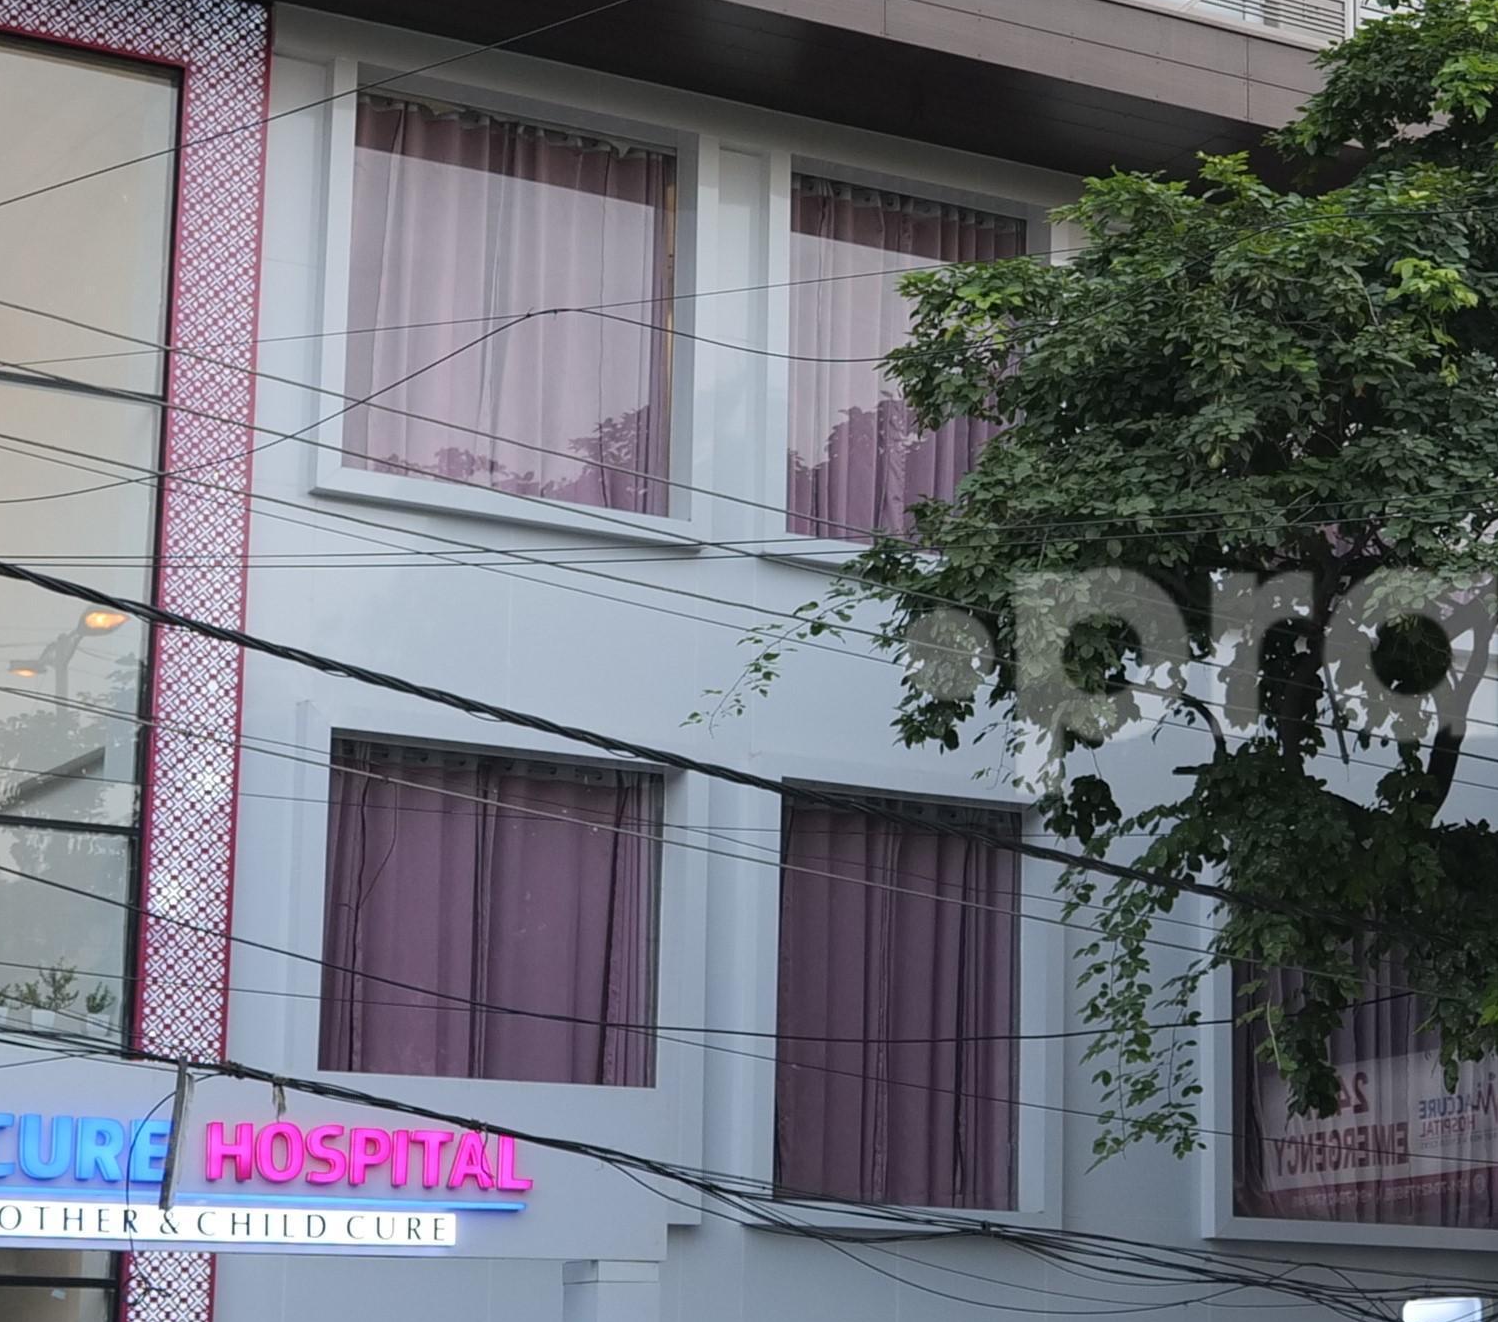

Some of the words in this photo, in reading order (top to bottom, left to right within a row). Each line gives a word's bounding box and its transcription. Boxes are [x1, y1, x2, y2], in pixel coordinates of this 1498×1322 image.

[205, 1118, 535, 1193] HOSPITAL
[159, 1207, 185, 1236] &
[196, 1208, 329, 1241] CHILD
[346, 1213, 450, 1245] CURE
